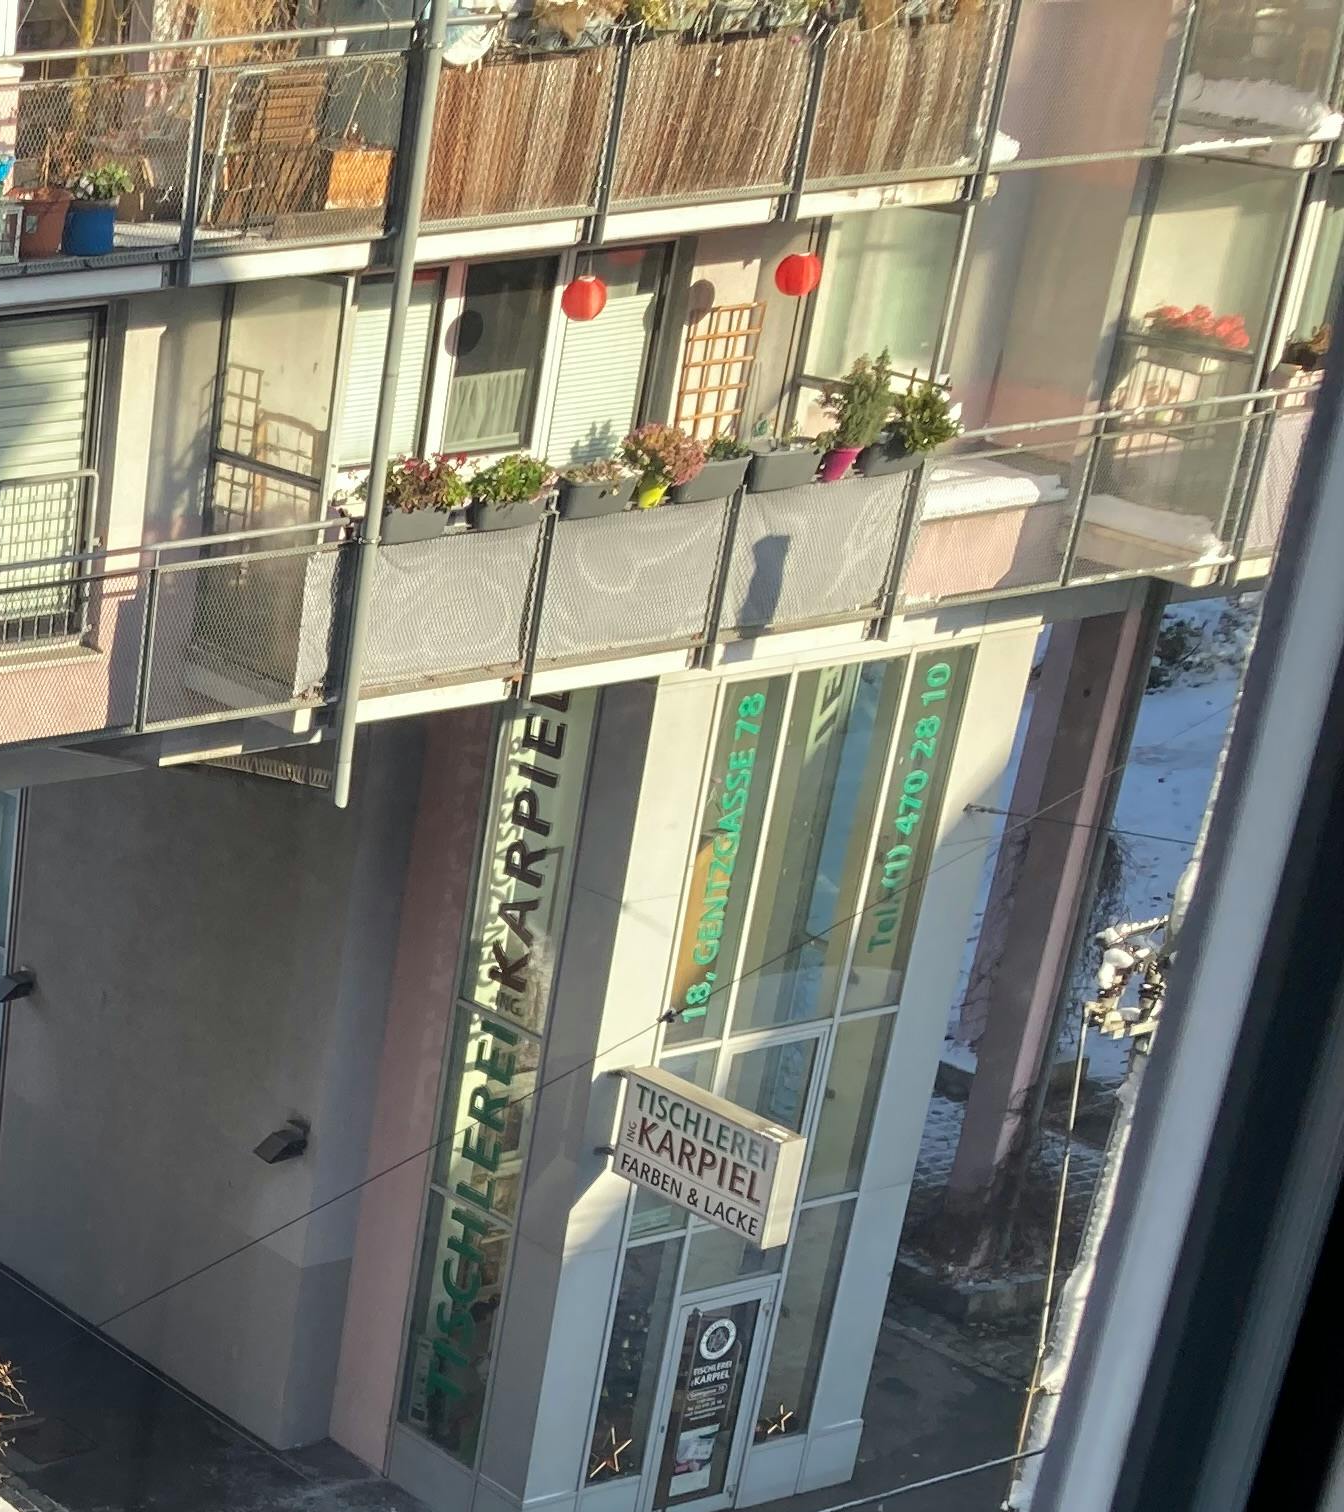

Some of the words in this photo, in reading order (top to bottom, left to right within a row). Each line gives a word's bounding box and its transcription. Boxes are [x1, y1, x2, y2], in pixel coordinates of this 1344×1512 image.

[920, 662, 952, 707] 10
[910, 715, 941, 760] 28
[693, 747, 757, 966] GENTZGASSE
[733, 692, 766, 742] 78
[894, 769, 929, 837] 470
[627, 1120, 637, 1143] ING
[638, 1117, 761, 1204] KARPIEL
[636, 1083, 770, 1172] TISCHLEREI
[426, 1019, 519, 1398] TISCHLEREI
[620, 1152, 683, 1199] FARBEN
[687, 1187, 698, 1208] &
[704, 1196, 759, 1237] LACKE
[694, 1369, 730, 1386] KARPIEL
